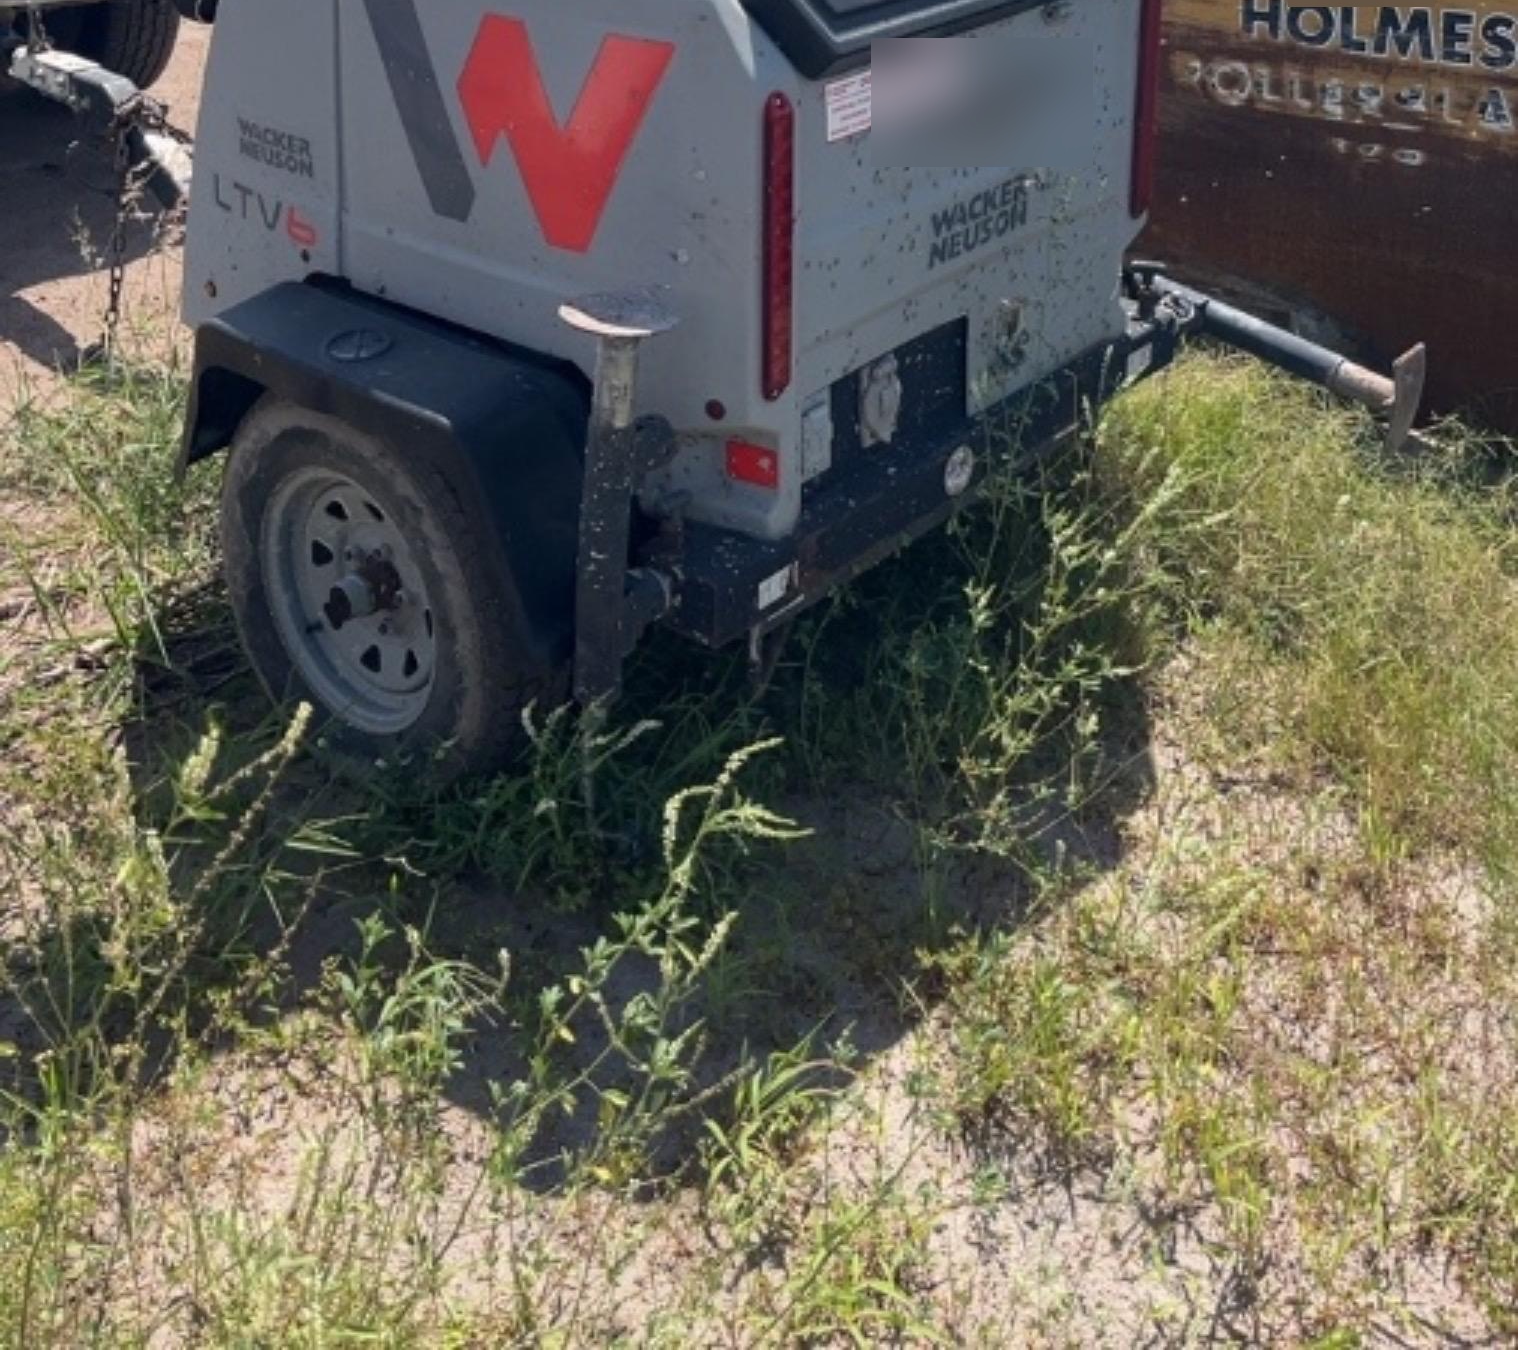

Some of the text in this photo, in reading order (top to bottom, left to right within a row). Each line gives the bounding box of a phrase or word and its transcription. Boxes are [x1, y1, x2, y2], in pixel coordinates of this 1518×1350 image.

[237, 115, 311, 154] WACKER
[240, 138, 314, 179] NEUSON
[930, 175, 1028, 238] WACKER
[928, 202, 1028, 270] NEUSON
